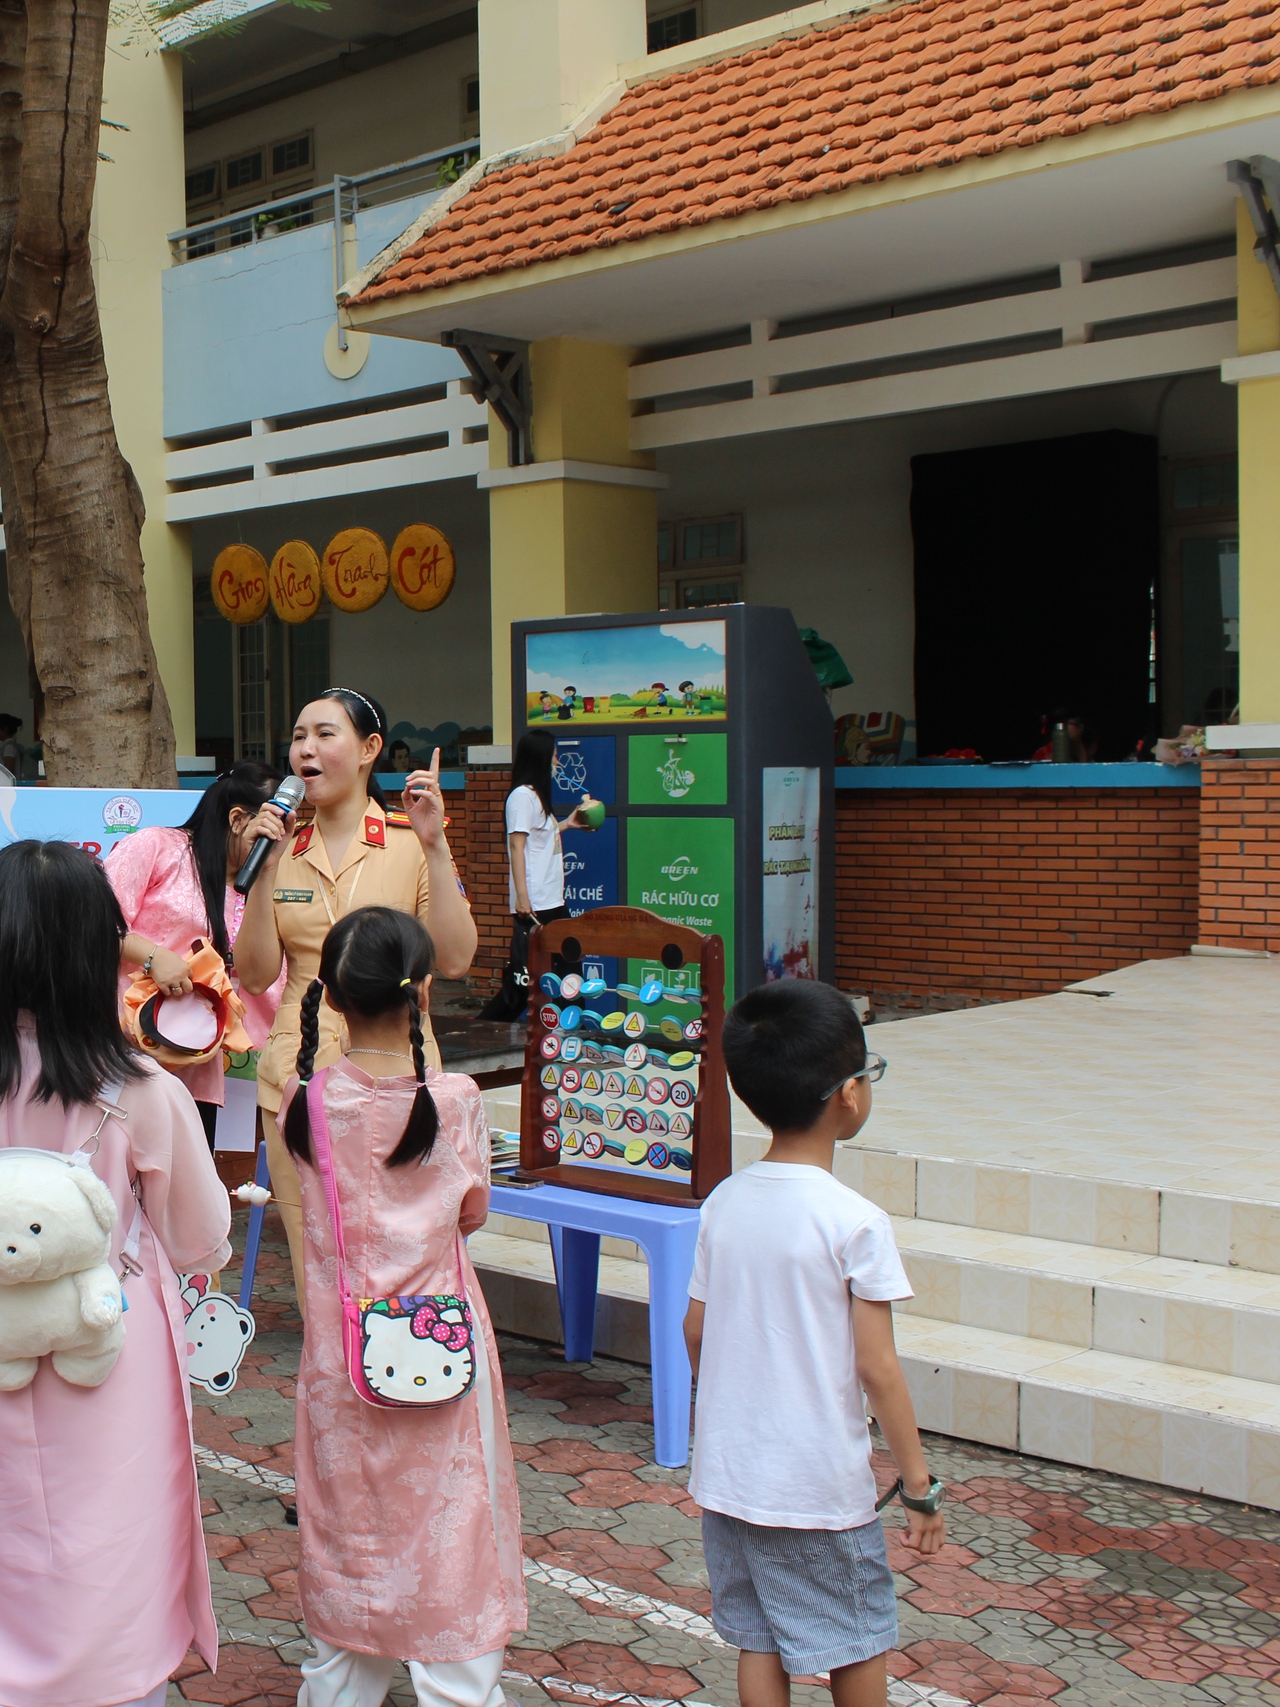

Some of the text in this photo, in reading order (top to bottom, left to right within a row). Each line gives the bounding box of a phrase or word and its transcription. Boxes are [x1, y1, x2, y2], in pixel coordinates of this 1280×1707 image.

[397, 544, 445, 595] Cát
[769, 822, 791, 841] PHÂN
[563, 862, 586, 870] EEN
[661, 866, 699, 875] GREEN
[763, 858, 778, 876] RÁC
[563, 884, 604, 901] ÁI CHẾ
[641, 889, 720, 907] RÁC HỮU CƠ
[686, 916, 713, 926] Waste
[542, 1012, 557, 1023] STOP
[675, 1090, 687, 1100] 20
